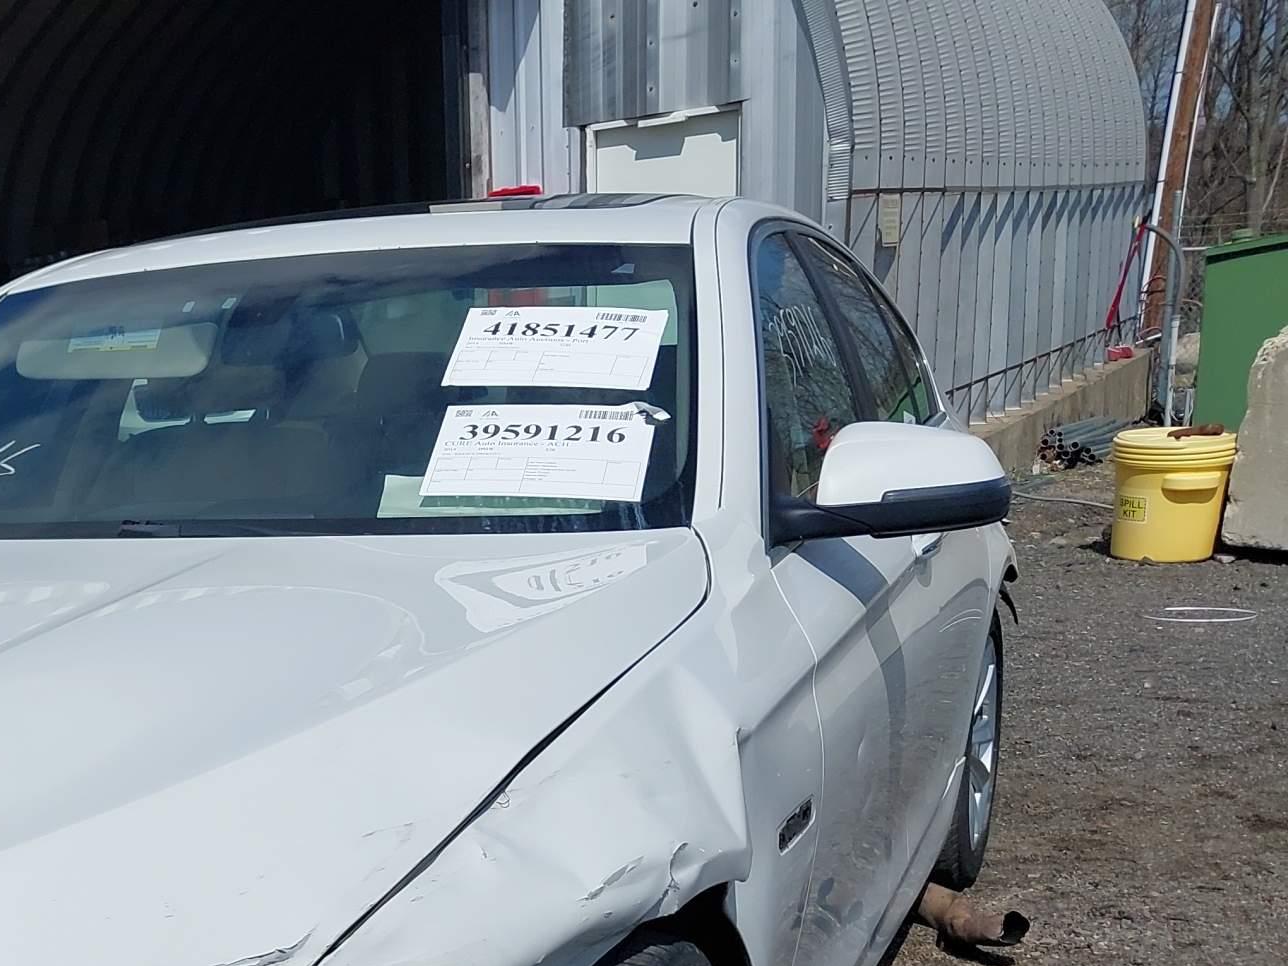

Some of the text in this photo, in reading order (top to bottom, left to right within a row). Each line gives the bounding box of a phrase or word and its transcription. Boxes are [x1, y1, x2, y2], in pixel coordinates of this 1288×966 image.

[483, 321, 641, 341] 41851477
[459, 424, 628, 443] 39591216
[1120, 498, 1143, 509] SPILL
[1122, 509, 1136, 518] KIT
